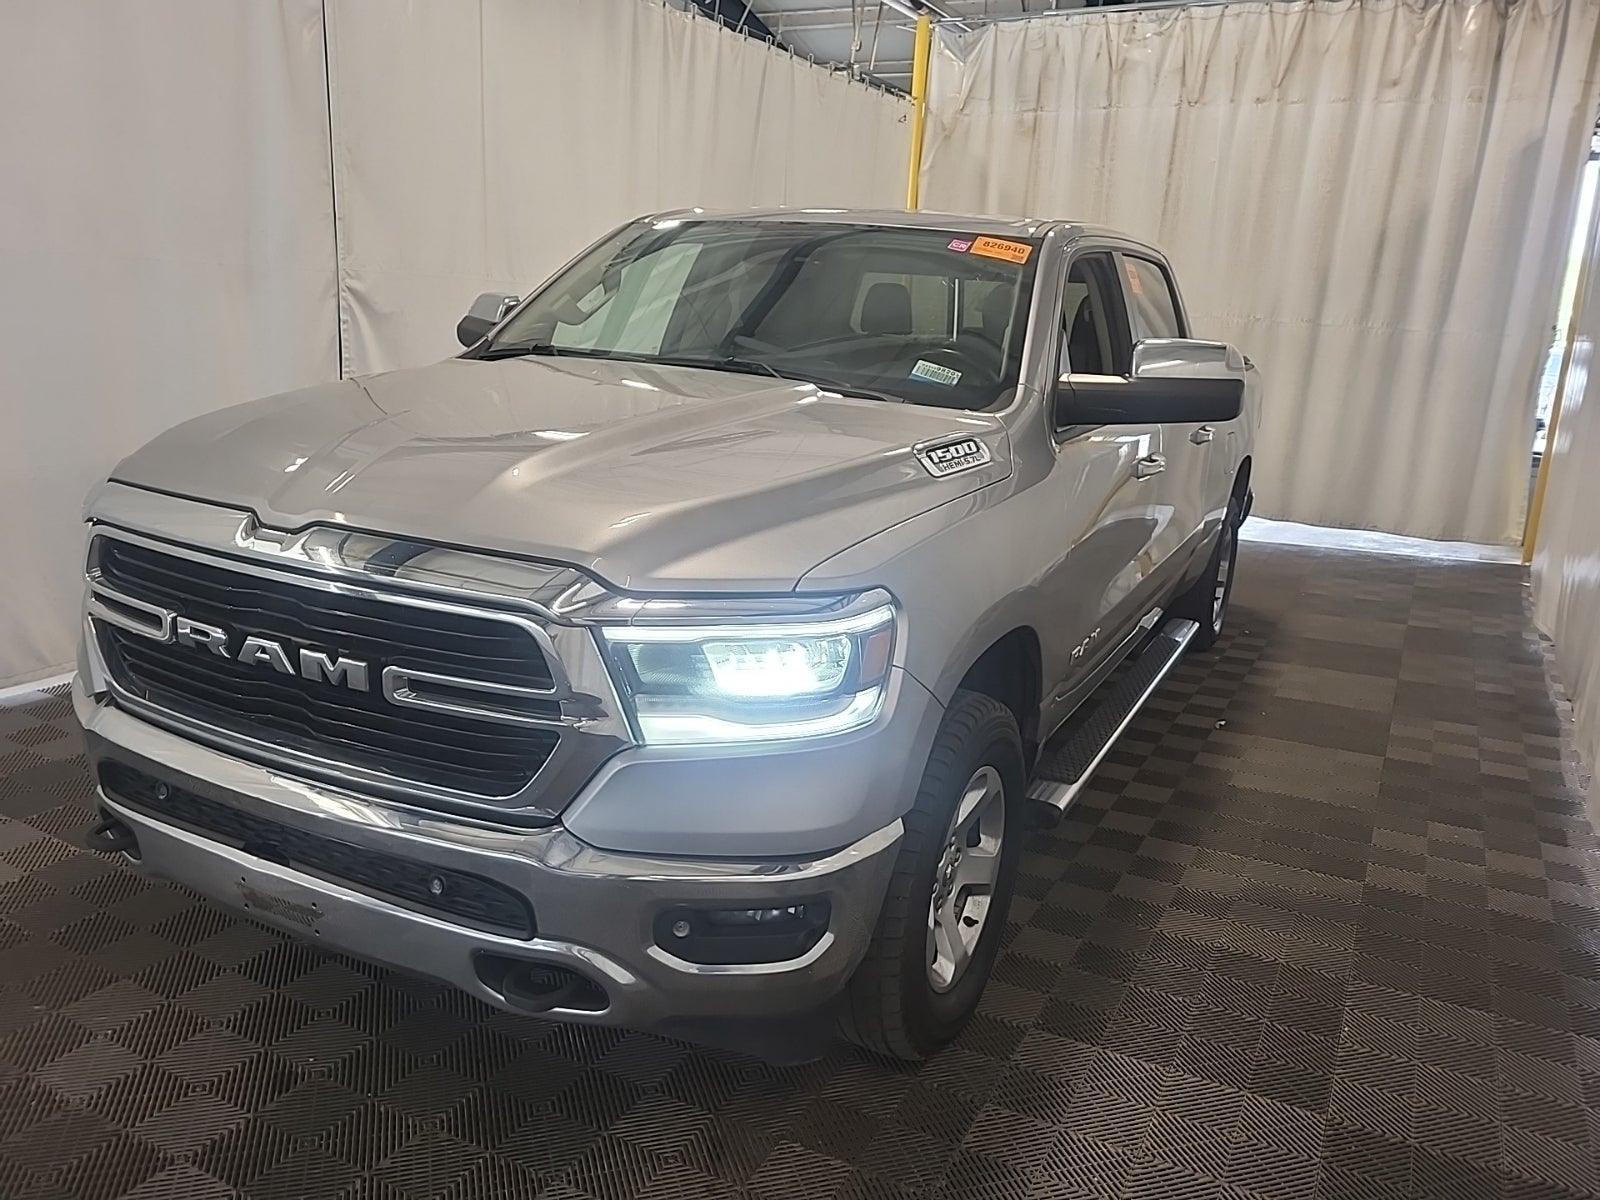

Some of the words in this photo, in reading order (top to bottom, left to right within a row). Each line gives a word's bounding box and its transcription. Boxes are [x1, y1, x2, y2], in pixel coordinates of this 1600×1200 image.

[983, 241, 1026, 254] 826940
[927, 441, 978, 463] 1500
[176, 616, 370, 692] RAM
